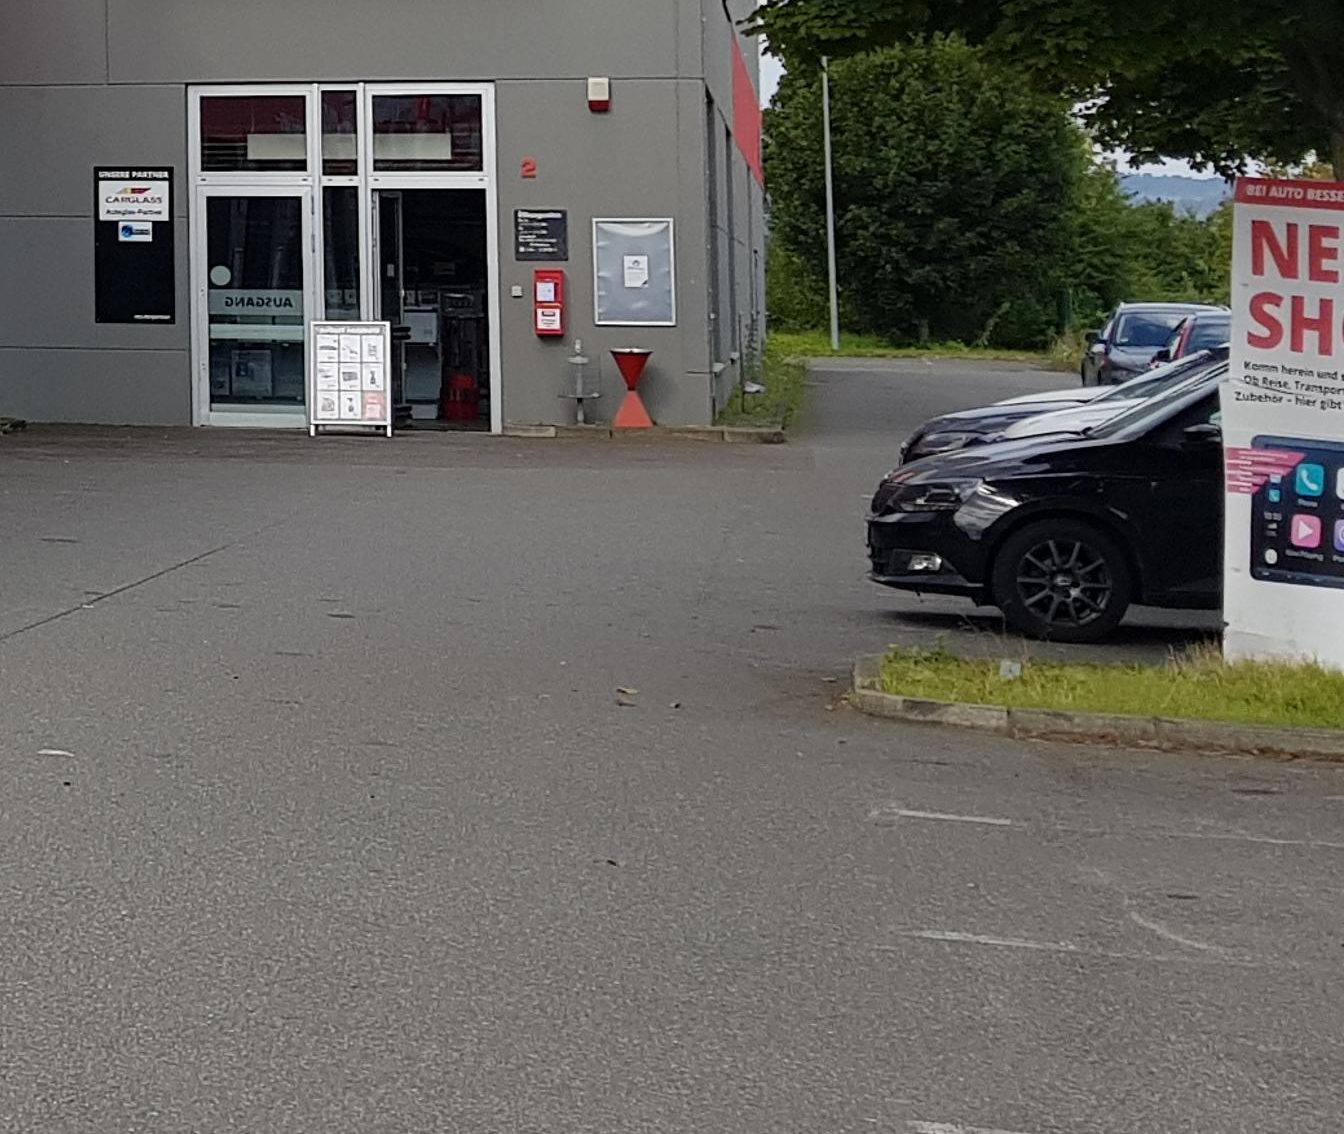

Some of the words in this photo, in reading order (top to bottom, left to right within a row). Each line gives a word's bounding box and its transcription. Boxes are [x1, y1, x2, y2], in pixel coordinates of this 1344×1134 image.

[132, 171, 169, 179] PARTNER
[105, 196, 163, 204] CARGLASS
[1246, 185, 1266, 197] BEI
[1269, 186, 1304, 200] AUTO
[1251, 220, 1340, 283] NE
[1247, 291, 1344, 356] SH
[1243, 361, 1279, 374] Komm
[1281, 365, 1315, 377] herein
[1316, 370, 1338, 380] und
[1244, 375, 1260, 386] Ob
[1234, 390, 1284, 403] Zubehör
[1295, 395, 1317, 407] hier
[1320, 398, 1342, 411] gibt
